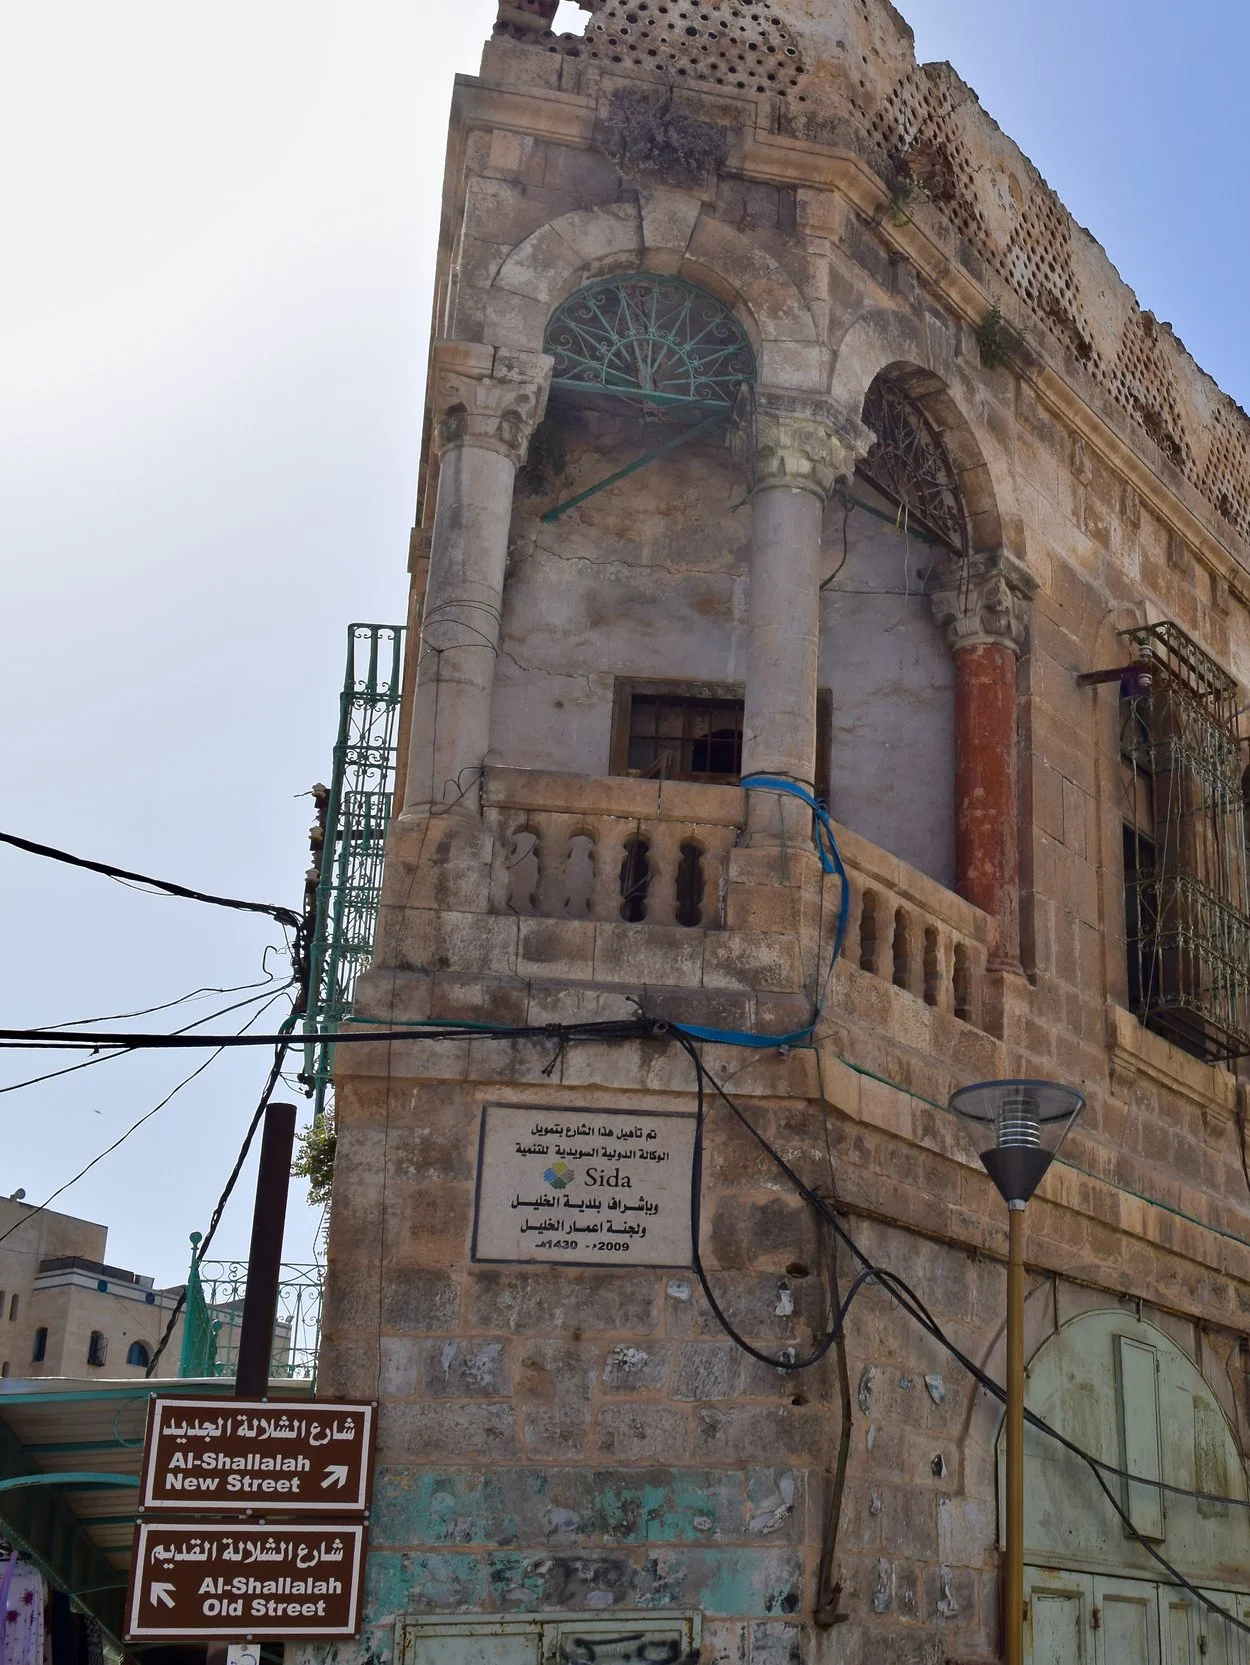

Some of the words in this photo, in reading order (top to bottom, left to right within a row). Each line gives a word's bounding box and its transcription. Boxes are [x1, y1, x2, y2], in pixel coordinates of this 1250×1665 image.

[531, 1123, 563, 1138] بتمويل
[565, 1123, 594, 1138] الشارع
[598, 1125, 614, 1137] هذا
[616, 1126, 643, 1141] تأهيل
[645, 1129, 657, 1141] تم
[515, 1142, 549, 1157] للتنمية
[555, 1144, 599, 1159] السويدية
[601, 1146, 636, 1161] الدولية
[638, 1148, 670, 1163] الوكالة
[584, 1168, 632, 1188] Sida
[511, 1193, 560, 1211] الخليل
[563, 1194, 602, 1213] بلدية
[607, 1195, 659, 1216] وبإشراف
[520, 1218, 564, 1235] الخليل
[565, 1220, 603, 1235] اعمار
[606, 1219, 647, 1238] ولجنة
[162, 1416, 232, 1443] الجديد
[236, 1415, 306, 1440] الشلالة
[308, 1417, 355, 1446] شارع
[168, 1452, 310, 1472] Al-Shallalah
[165, 1473, 220, 1491] New
[226, 1474, 300, 1492] Street
[151, 1538, 218, 1569] القديم
[221, 1537, 293, 1564] الشلالة
[296, 1538, 344, 1568] شارع
[198, 1577, 342, 1595] Al-Shallalah
[202, 1599, 243, 1616] Old
[251, 1599, 326, 1616] Street
